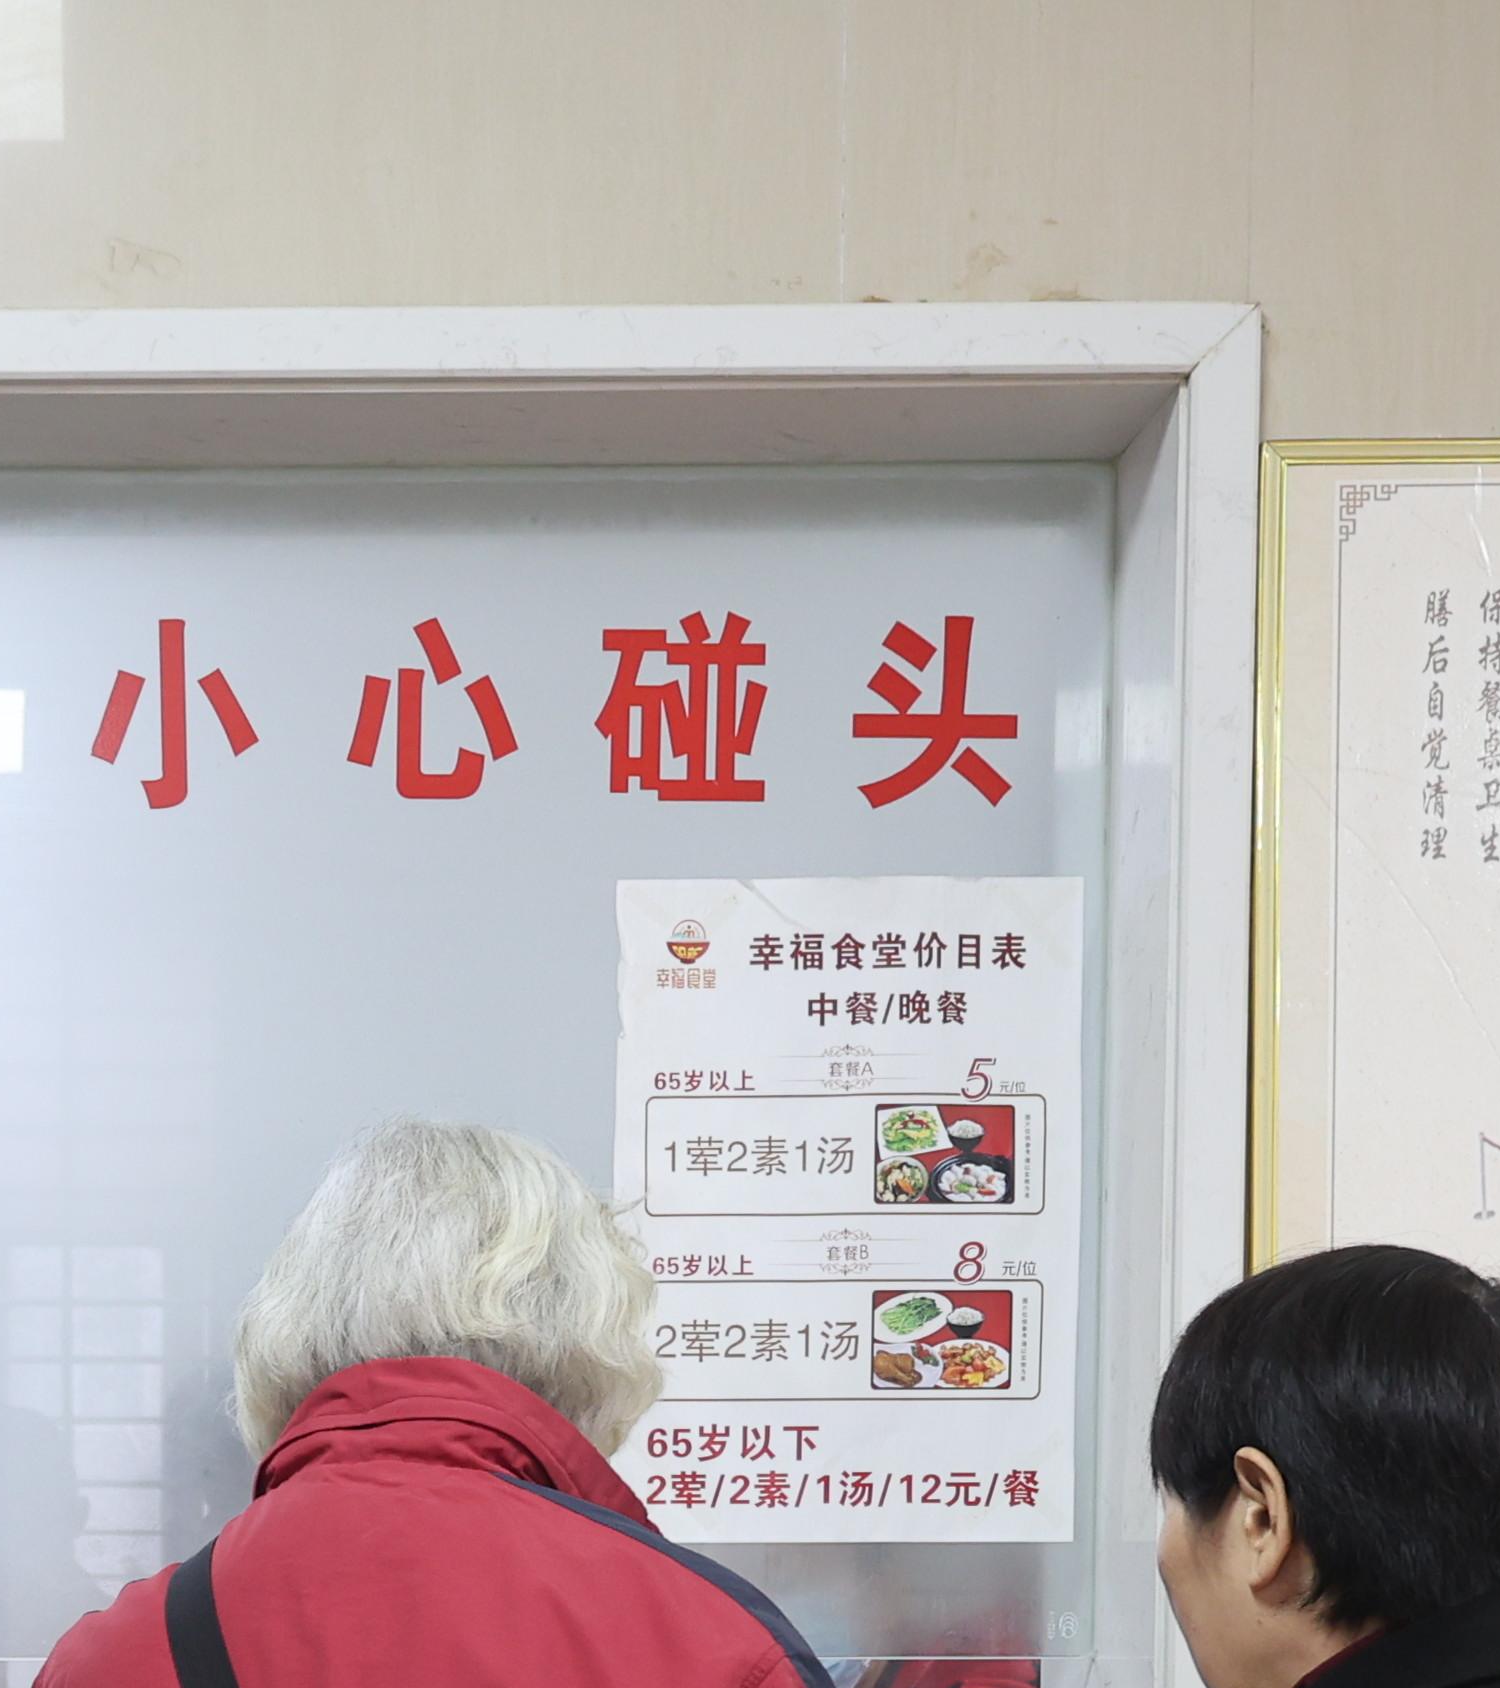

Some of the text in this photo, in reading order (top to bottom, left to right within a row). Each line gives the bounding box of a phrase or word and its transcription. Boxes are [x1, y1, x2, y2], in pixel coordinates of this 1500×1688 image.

[91, 611, 1018, 810] 小心碰头
[1420, 588, 1453, 861] 膳后自觉清理
[748, 930, 1028, 972] 幸福食堂价目表
[807, 990, 968, 1026] 中餐/晚餐
[653, 1069, 755, 1092] 65岁以上
[828, 1061, 874, 1079] 套餐A
[960, 1057, 997, 1102] 5
[664, 1135, 855, 1177] 1荤2素1汤
[652, 1253, 755, 1277] 65岁以上
[825, 1243, 870, 1262] 套餐B
[952, 1240, 1038, 1285] 8 元/位
[654, 1318, 860, 1363] 2荤2素1汤
[646, 1424, 821, 1461] 65岁以下
[646, 1469, 1040, 1509] 2荤/2素/1汤/12元/餐
